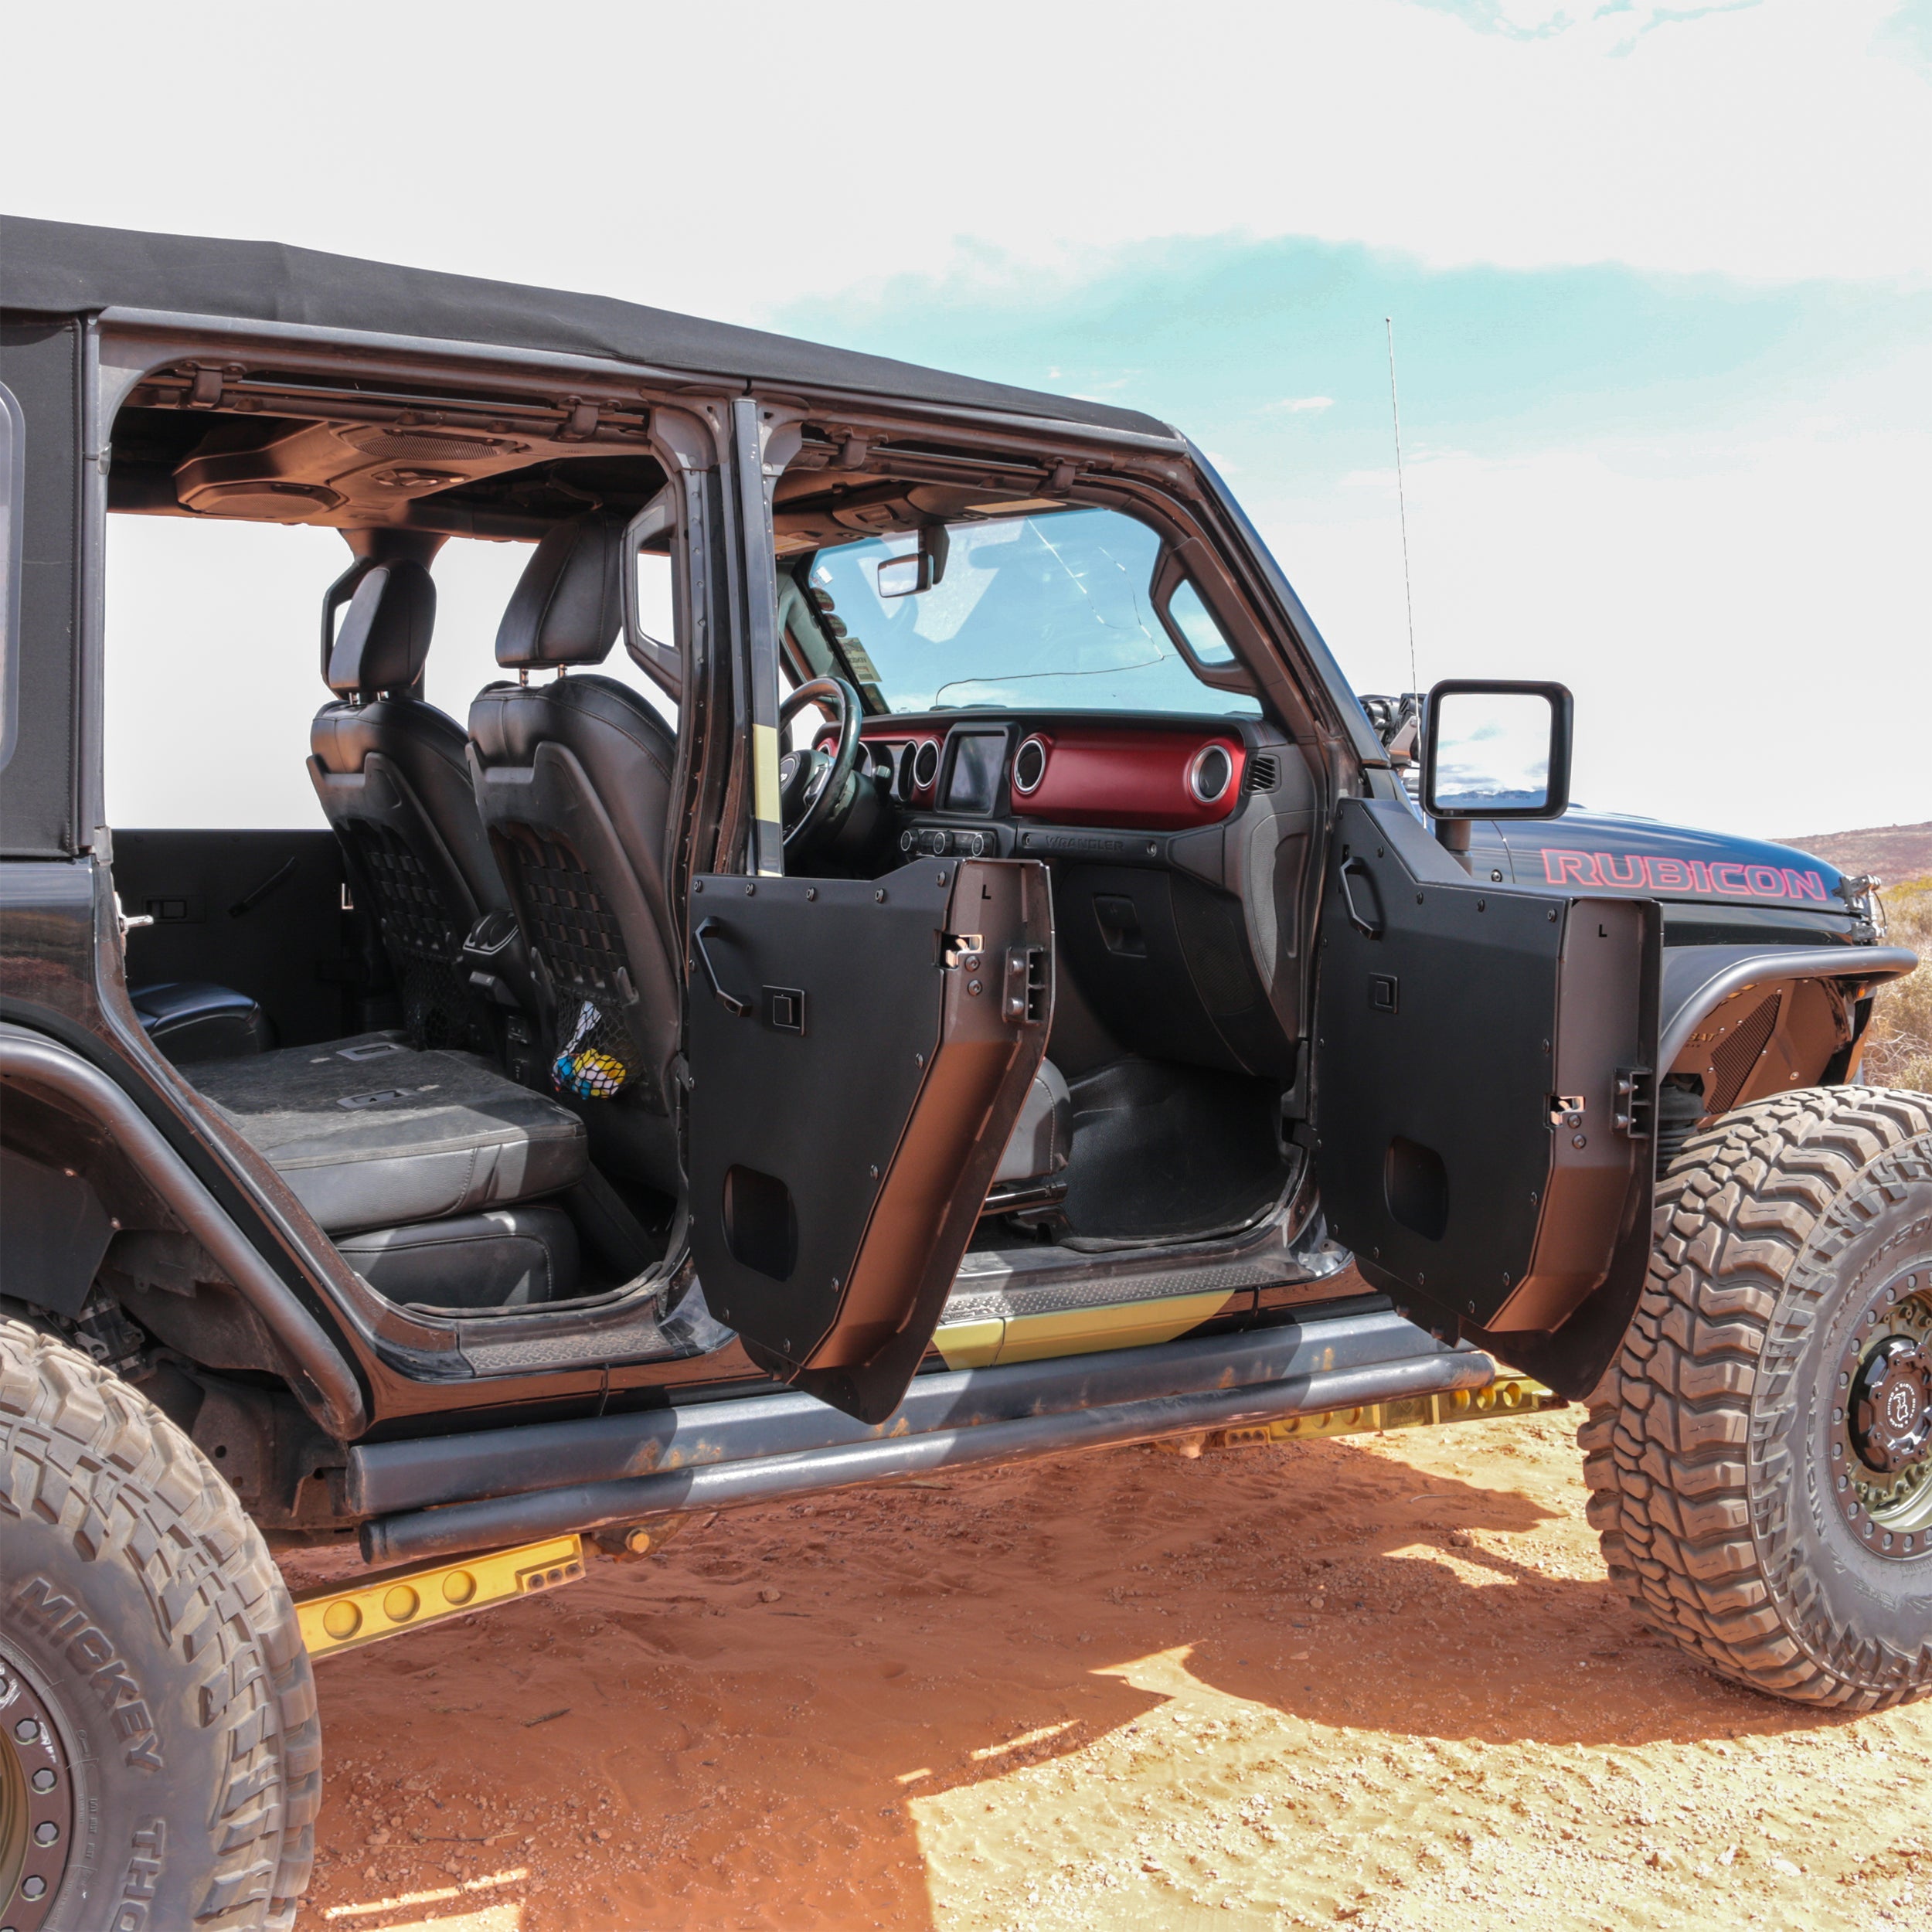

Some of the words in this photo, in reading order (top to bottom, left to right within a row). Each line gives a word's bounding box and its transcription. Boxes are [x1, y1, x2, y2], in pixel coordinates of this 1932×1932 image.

[1046, 835, 1124, 851] WRANGLER
[982, 884, 992, 900] L
[1541, 849, 1827, 901] RUBICON
[1599, 924, 1607, 937] L
[1823, 1214, 1932, 1351] THOMPSO
[14, 1577, 164, 1770] MICKEY
